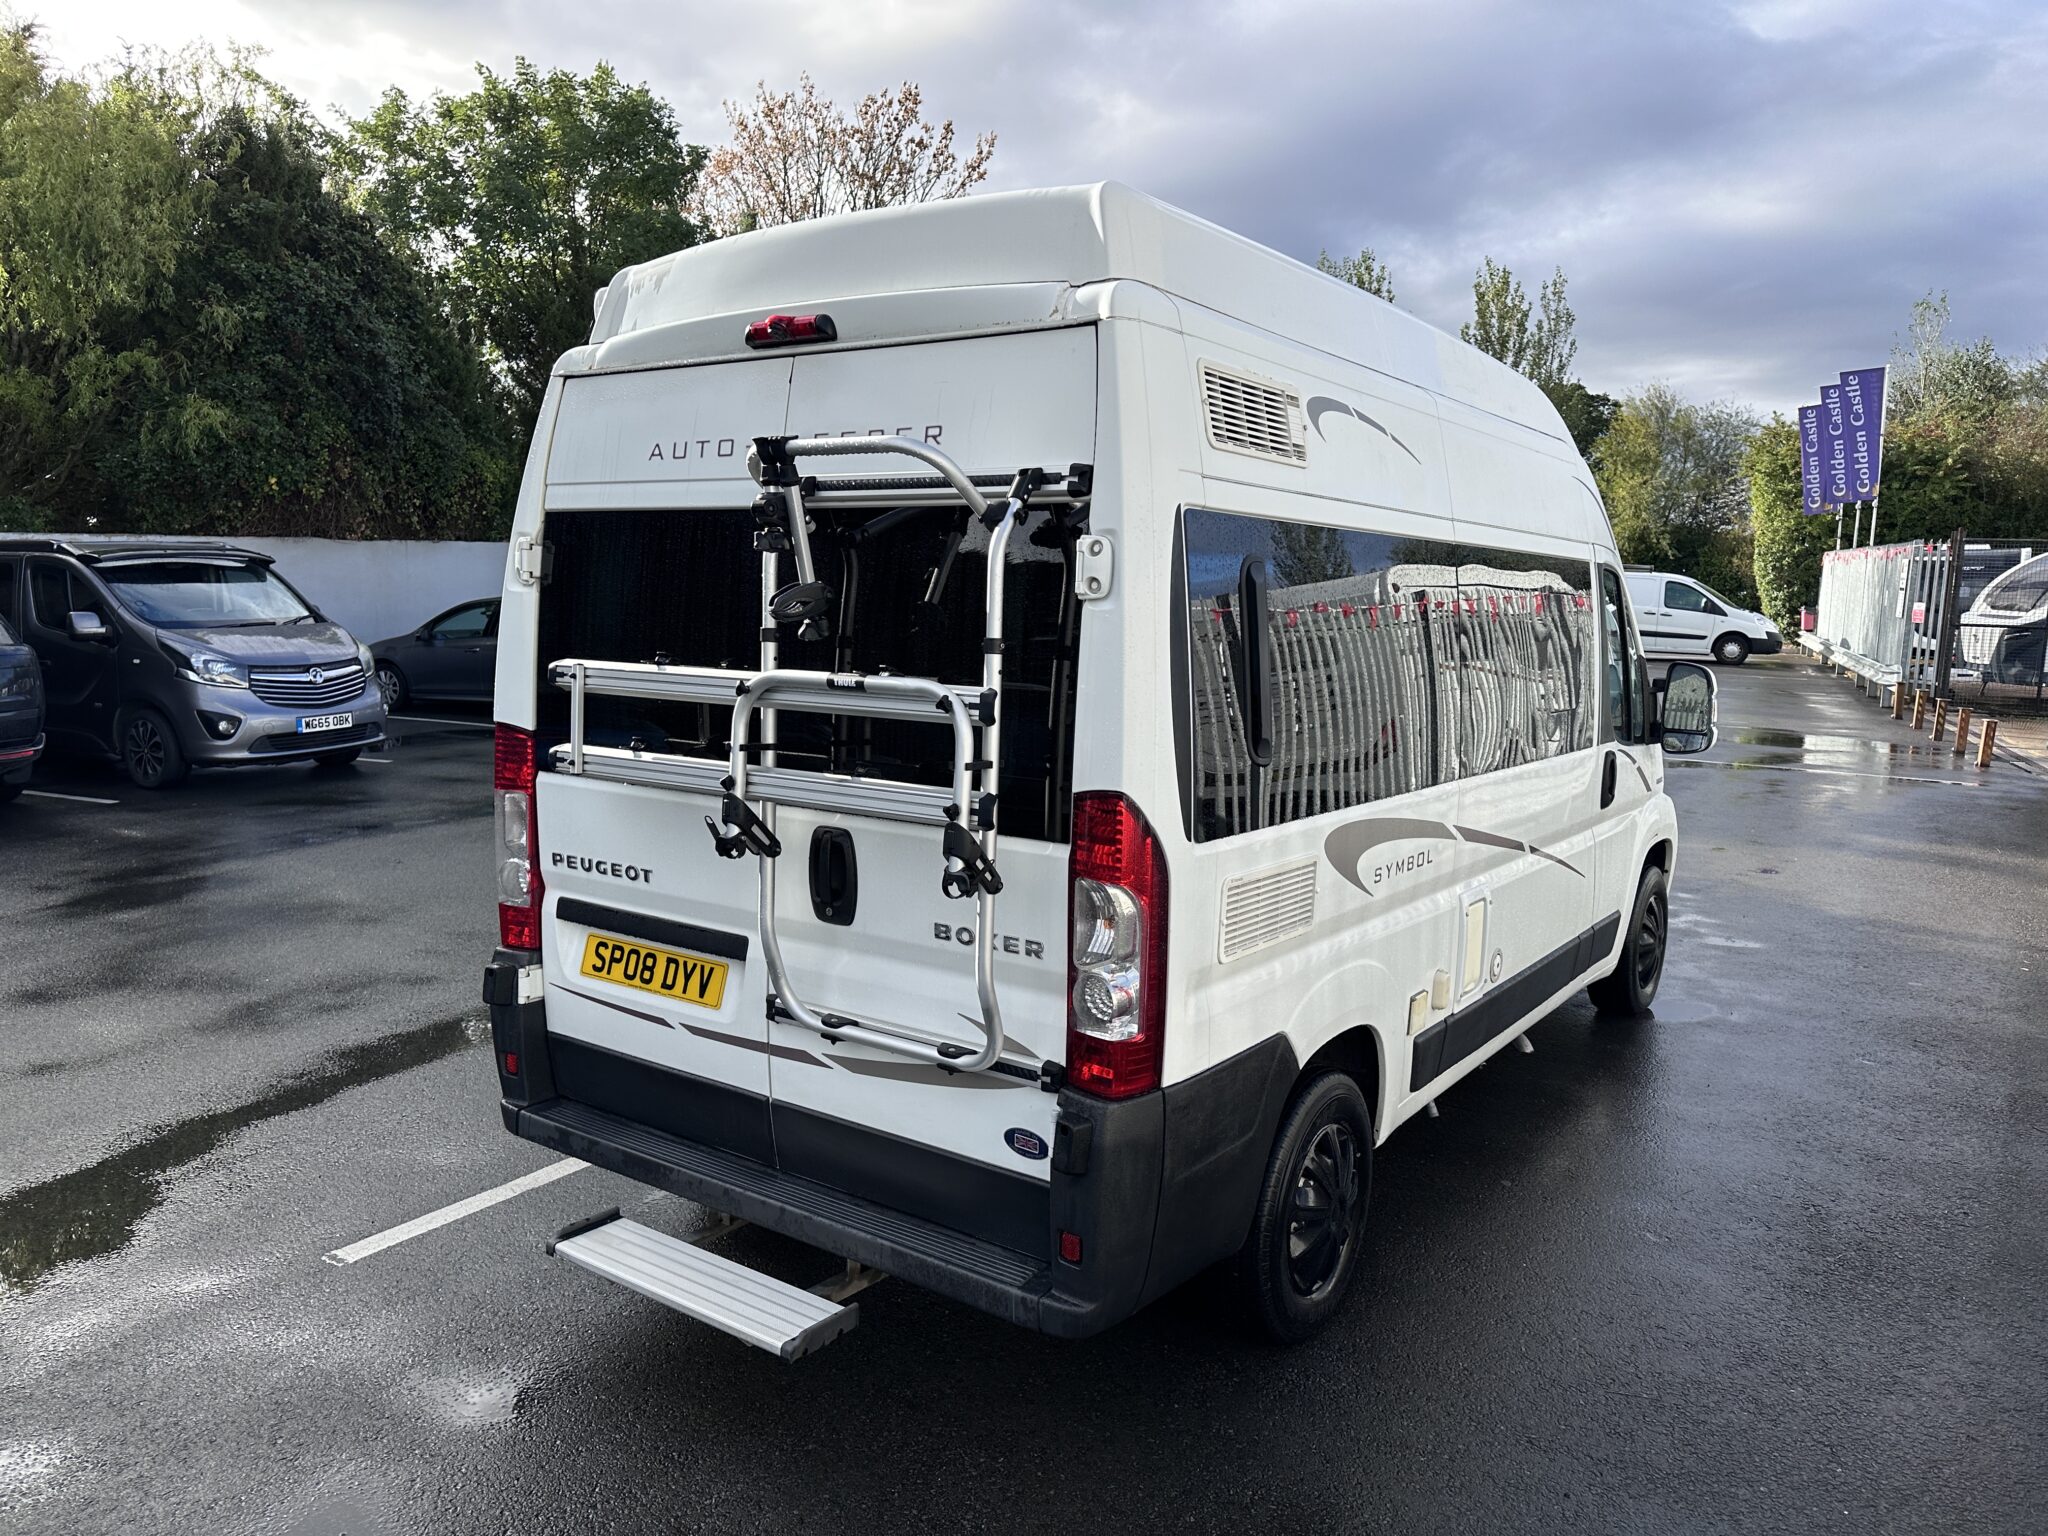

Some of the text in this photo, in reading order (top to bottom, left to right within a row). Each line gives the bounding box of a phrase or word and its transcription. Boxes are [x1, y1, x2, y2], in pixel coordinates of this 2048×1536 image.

[1826, 389, 1846, 497] Golden Castle
[1845, 375, 1870, 493] Golden Castle
[1803, 409, 1821, 509] Golden Castle
[834, 678, 856, 687] THULE
[304, 714, 351, 731] WG65 OBK
[552, 852, 653, 883] PEUGEOT
[1374, 849, 1433, 884] SYMBOL
[591, 940, 715, 999] SP08 DYV
